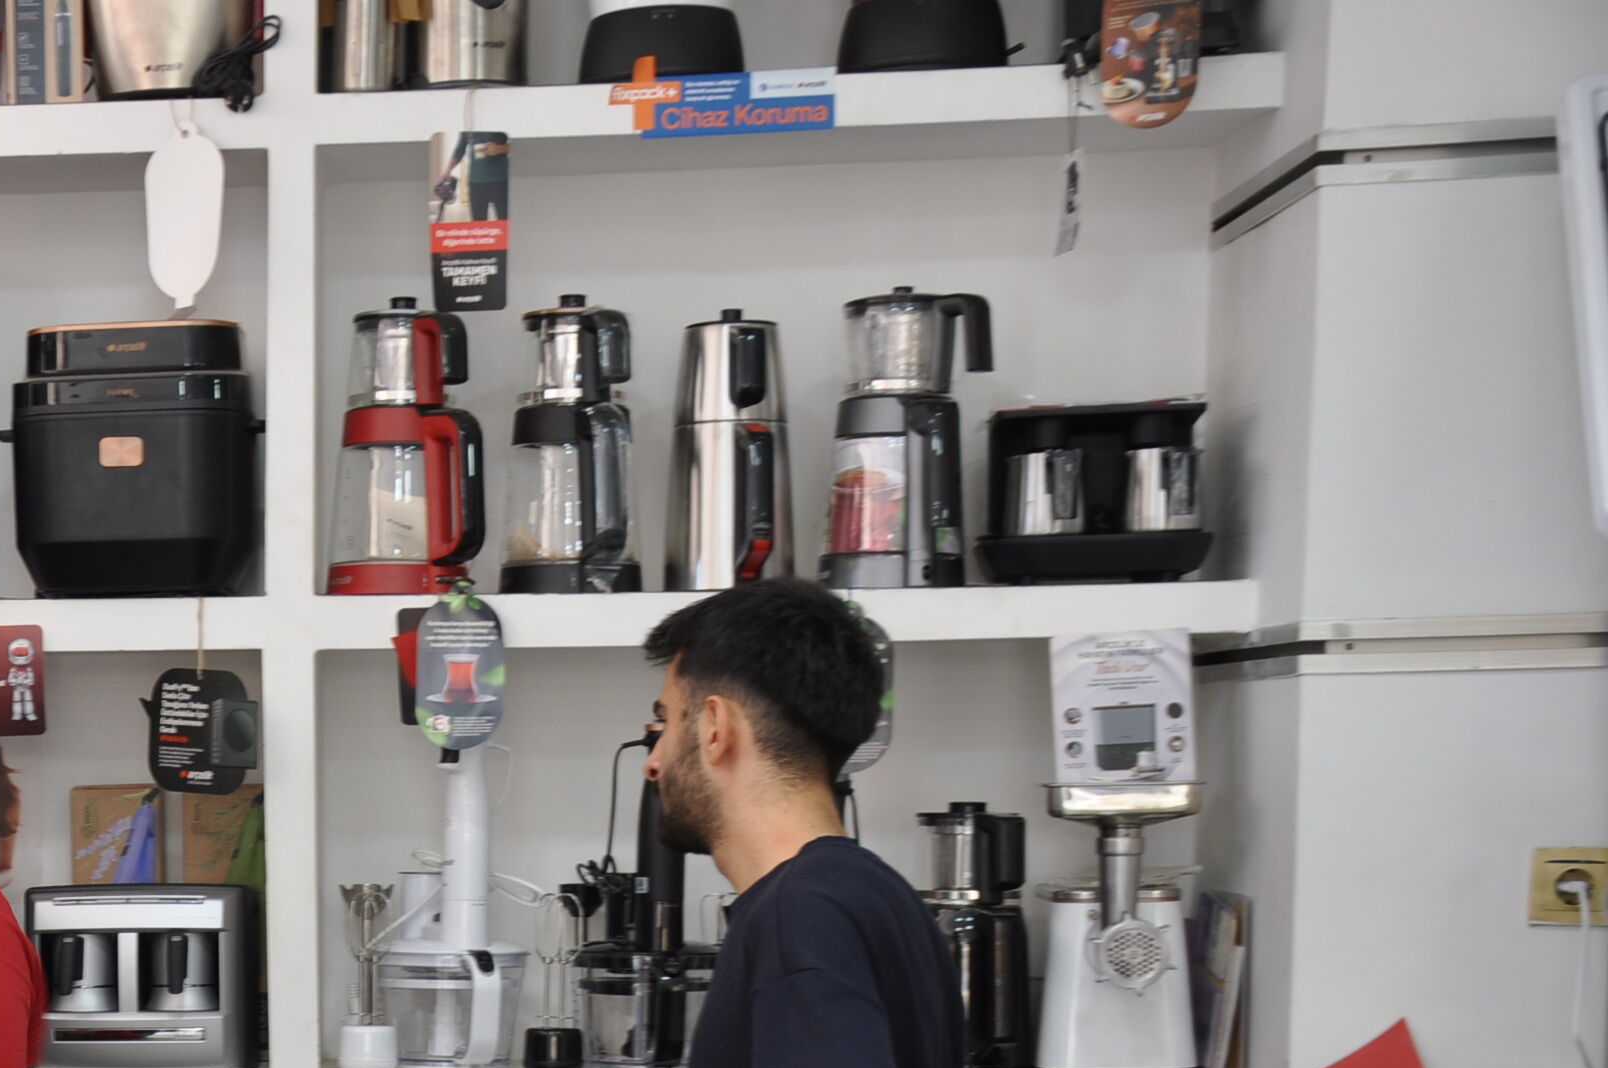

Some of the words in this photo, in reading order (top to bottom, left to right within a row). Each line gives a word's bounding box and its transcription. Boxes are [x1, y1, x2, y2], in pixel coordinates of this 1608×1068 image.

[611, 85, 679, 103] fixpack+
[660, 106, 730, 130] Cihaz
[734, 103, 829, 126] Koruma
